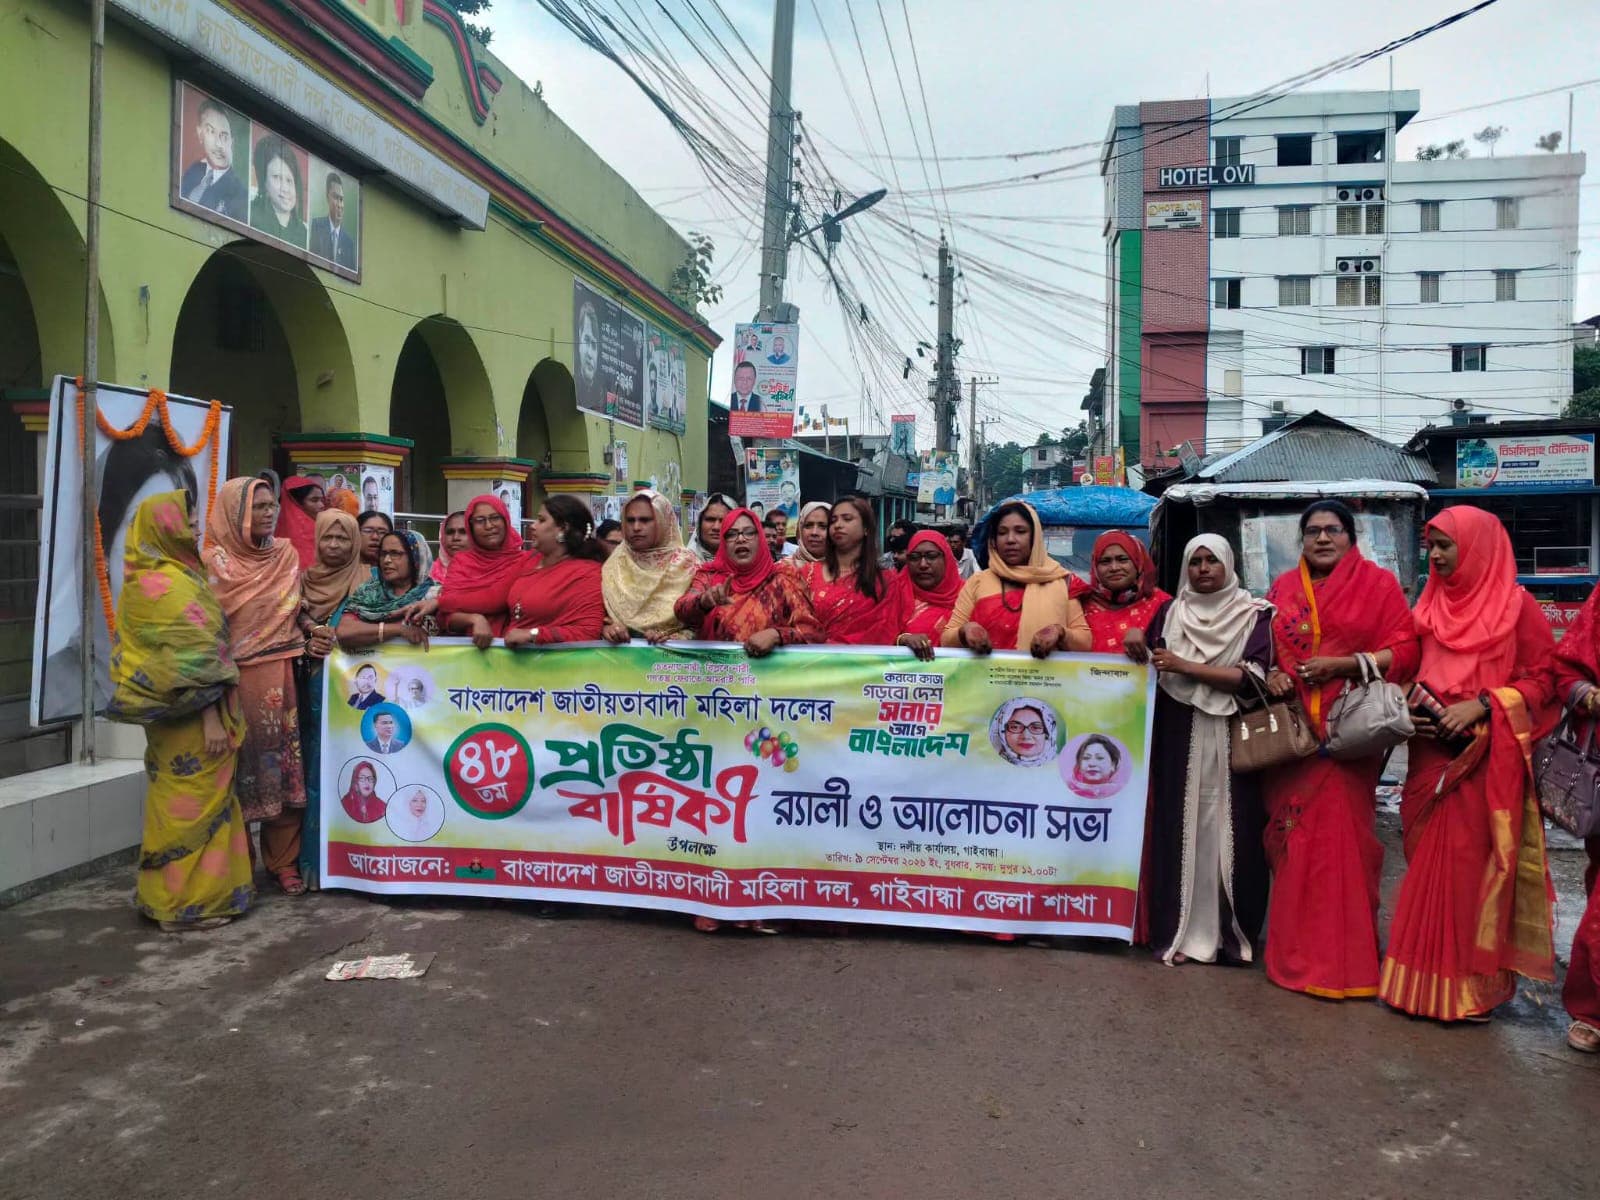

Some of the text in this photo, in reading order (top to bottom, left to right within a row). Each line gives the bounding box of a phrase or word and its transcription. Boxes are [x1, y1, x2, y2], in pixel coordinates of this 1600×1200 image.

[1161, 166, 1253, 186] HOTEL OVI
[1156, 202, 1201, 213] HOTEL OVI
[885, 672, 943, 684] করবো কাজ
[1090, 667, 1130, 678] জিন্দাবাদ
[448, 682, 835, 724] বাংলাদেশ জাতীয়তাবাদী মহিলা দলের
[864, 685, 943, 702] গড়বো দেশ
[878, 702, 943, 730] সবার
[889, 723, 927, 736] আগে
[848, 728, 970, 757] বাংলাদেশ
[457, 736, 519, 785] ৪৮
[540, 723, 713, 788] প্রতিষ্ঠা
[474, 782, 509, 804] তম
[557, 765, 760, 845] বার্ষিকী
[858, 794, 882, 830] ও
[890, 795, 1040, 839] আলোচনা
[1044, 803, 1112, 844] সভা
[667, 836, 719, 857] উপলক্ষে
[899, 841, 921, 854] দলীয়
[502, 857, 598, 884] বাংলাদেশ
[605, 858, 734, 900] জাতীয়তাবাদী
[741, 873, 807, 902] মহিলা
[816, 879, 859, 908] দল,
[870, 876, 965, 912] গাইবান্ধা
[973, 888, 1034, 916] জেলা
